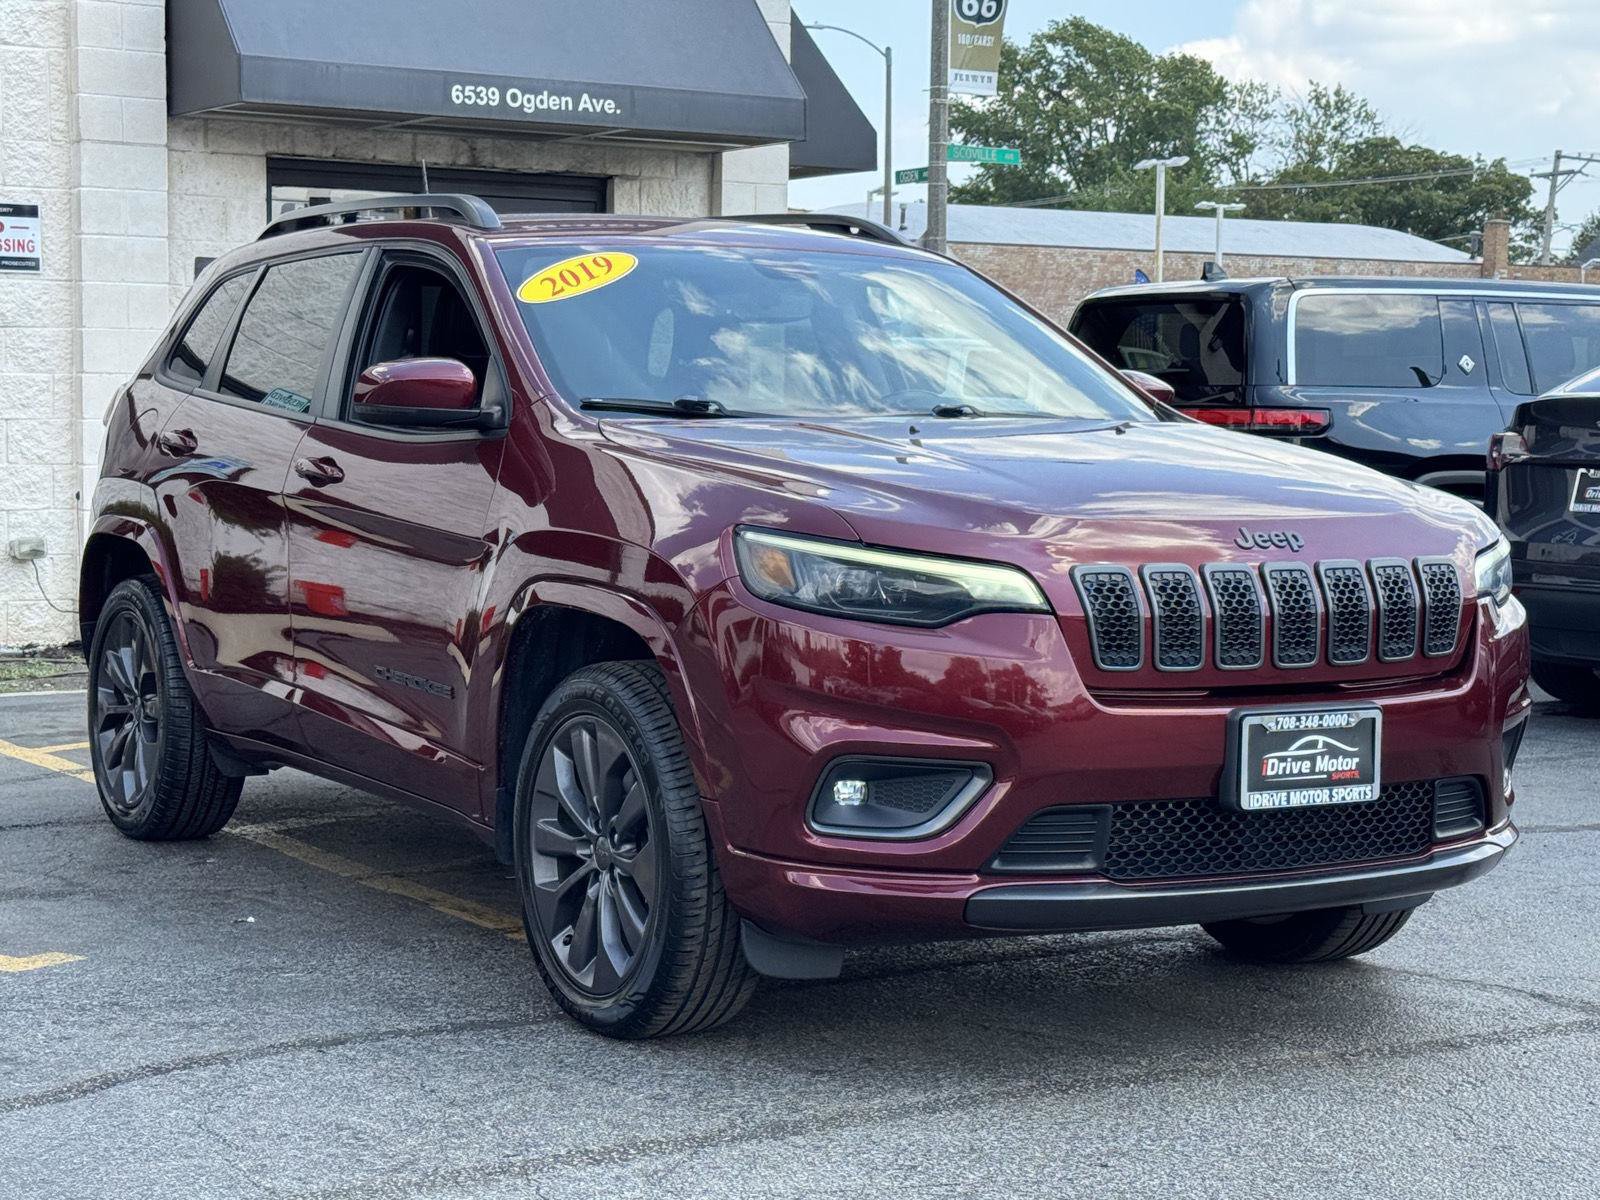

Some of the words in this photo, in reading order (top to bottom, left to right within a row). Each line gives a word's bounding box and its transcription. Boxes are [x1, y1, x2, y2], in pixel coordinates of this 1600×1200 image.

[962, 0, 997, 18] 66
[451, 84, 500, 106] 6539
[505, 88, 573, 113] Ogden
[578, 93, 622, 114] Ave.
[952, 147, 997, 161] SCOVILLE
[540, 256, 613, 297] 2019
[1233, 527, 1305, 553] Jeep
[1276, 713, 1348, 730] 708-348-0000
[1261, 757, 1311, 777] iDrive
[1315, 755, 1360, 772] Motor
[1331, 771, 1360, 780] SPORTS
[1289, 789, 1331, 805] MOTOR
[1332, 785, 1372, 801] SPORTS
